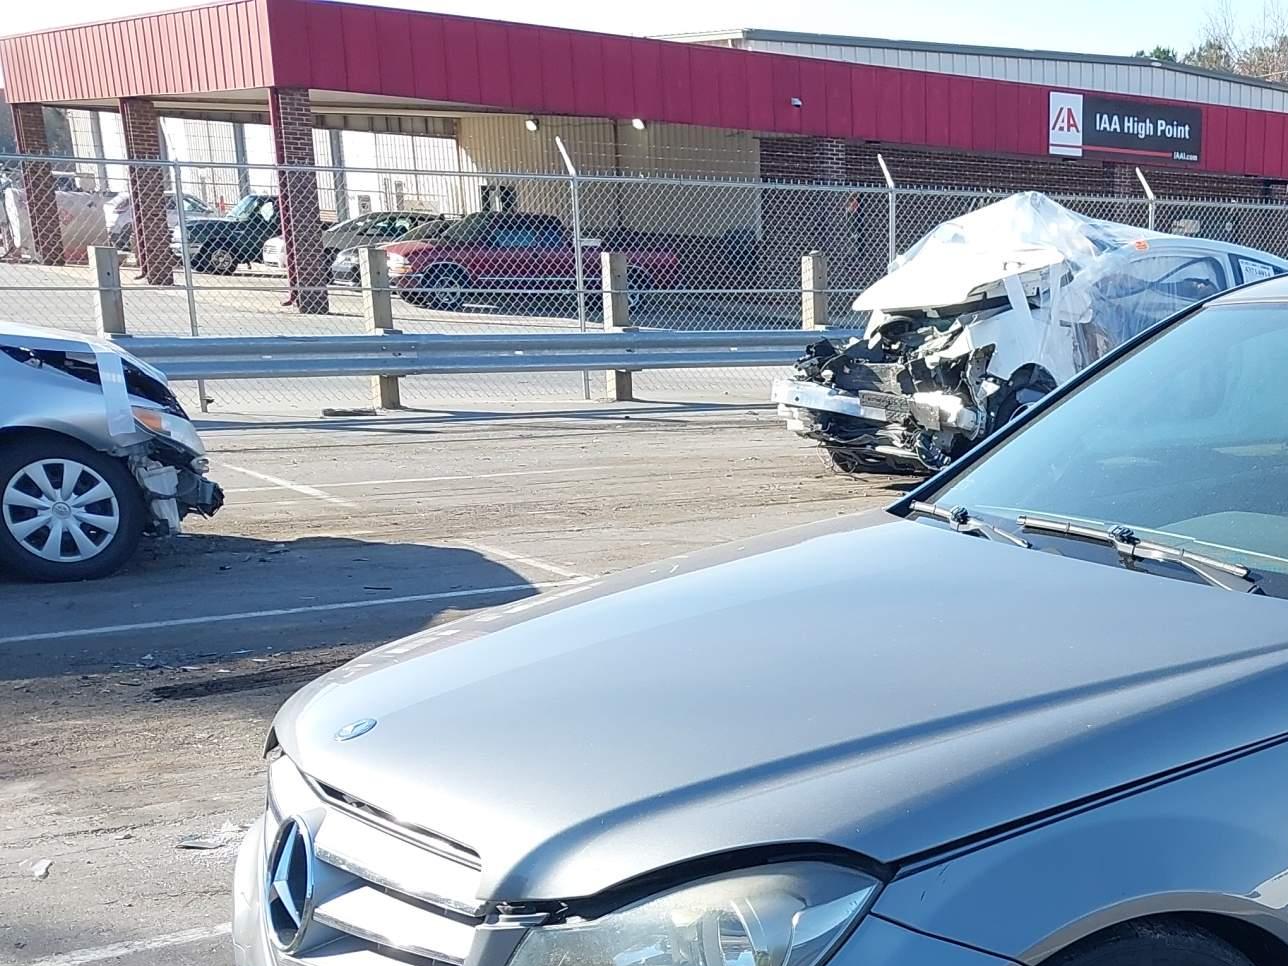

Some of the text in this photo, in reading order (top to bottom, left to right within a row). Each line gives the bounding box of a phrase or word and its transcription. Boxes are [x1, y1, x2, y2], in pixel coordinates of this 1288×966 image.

[1095, 113, 1190, 139] IAA High Point
